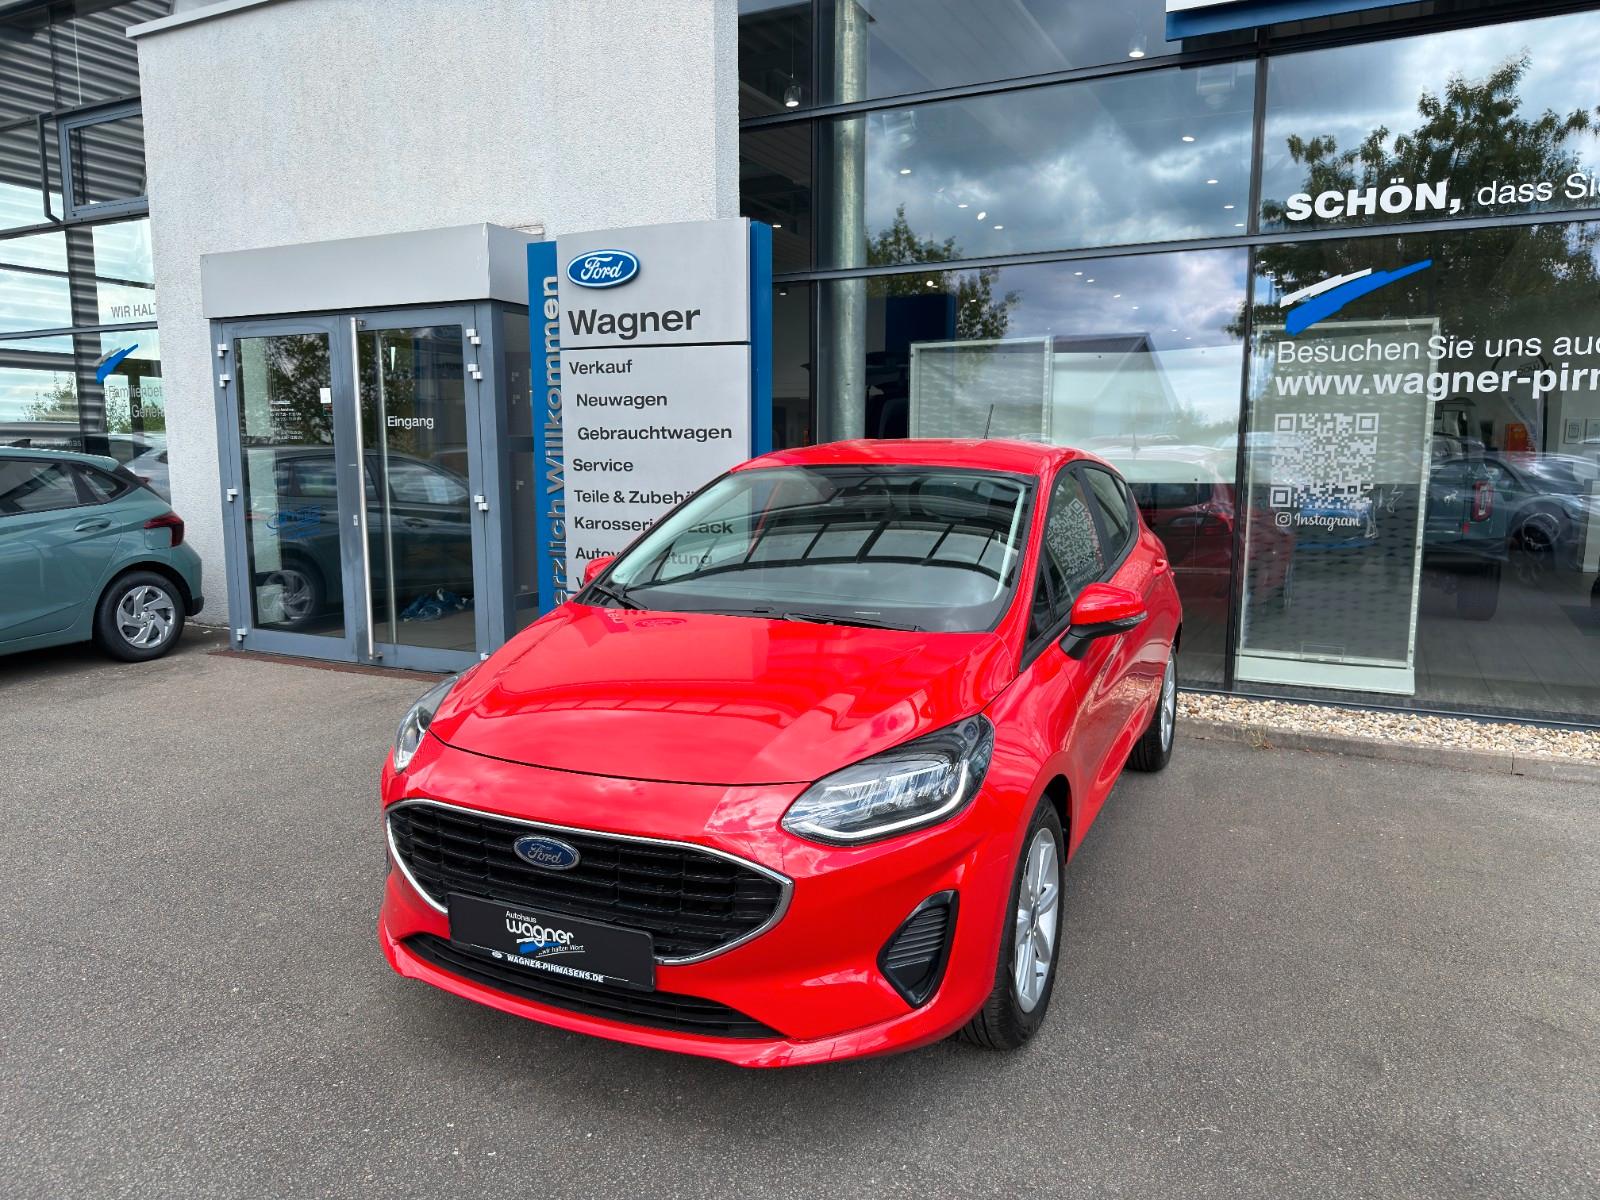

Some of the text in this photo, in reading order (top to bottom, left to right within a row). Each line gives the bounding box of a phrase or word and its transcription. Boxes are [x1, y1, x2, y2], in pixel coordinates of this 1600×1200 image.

[1286, 172, 1600, 221] SCHÖN, dass Si
[110, 303, 156, 318] WIR HAL
[567, 309, 701, 340] Wagner
[1277, 338, 1419, 364] Besuchen
[1427, 334, 1474, 360] Sie
[1485, 335, 1543, 357] uns
[569, 359, 632, 375] Verkauf
[576, 393, 667, 409] Neuwagen
[387, 415, 434, 430] Eingang
[543, 276, 568, 605] erzlich Willkommen
[577, 426, 732, 442] Gebrauchtwagen
[572, 458, 634, 471] Service
[574, 490, 694, 504] Teile & Zubeh
[574, 516, 653, 532] Karosseri
[1294, 512, 1361, 532] Instagram
[505, 910, 537, 923] Autohaus
[506, 918, 574, 947] wagner
[507, 953, 604, 983] WAGNER-PIRMASENS.DE
